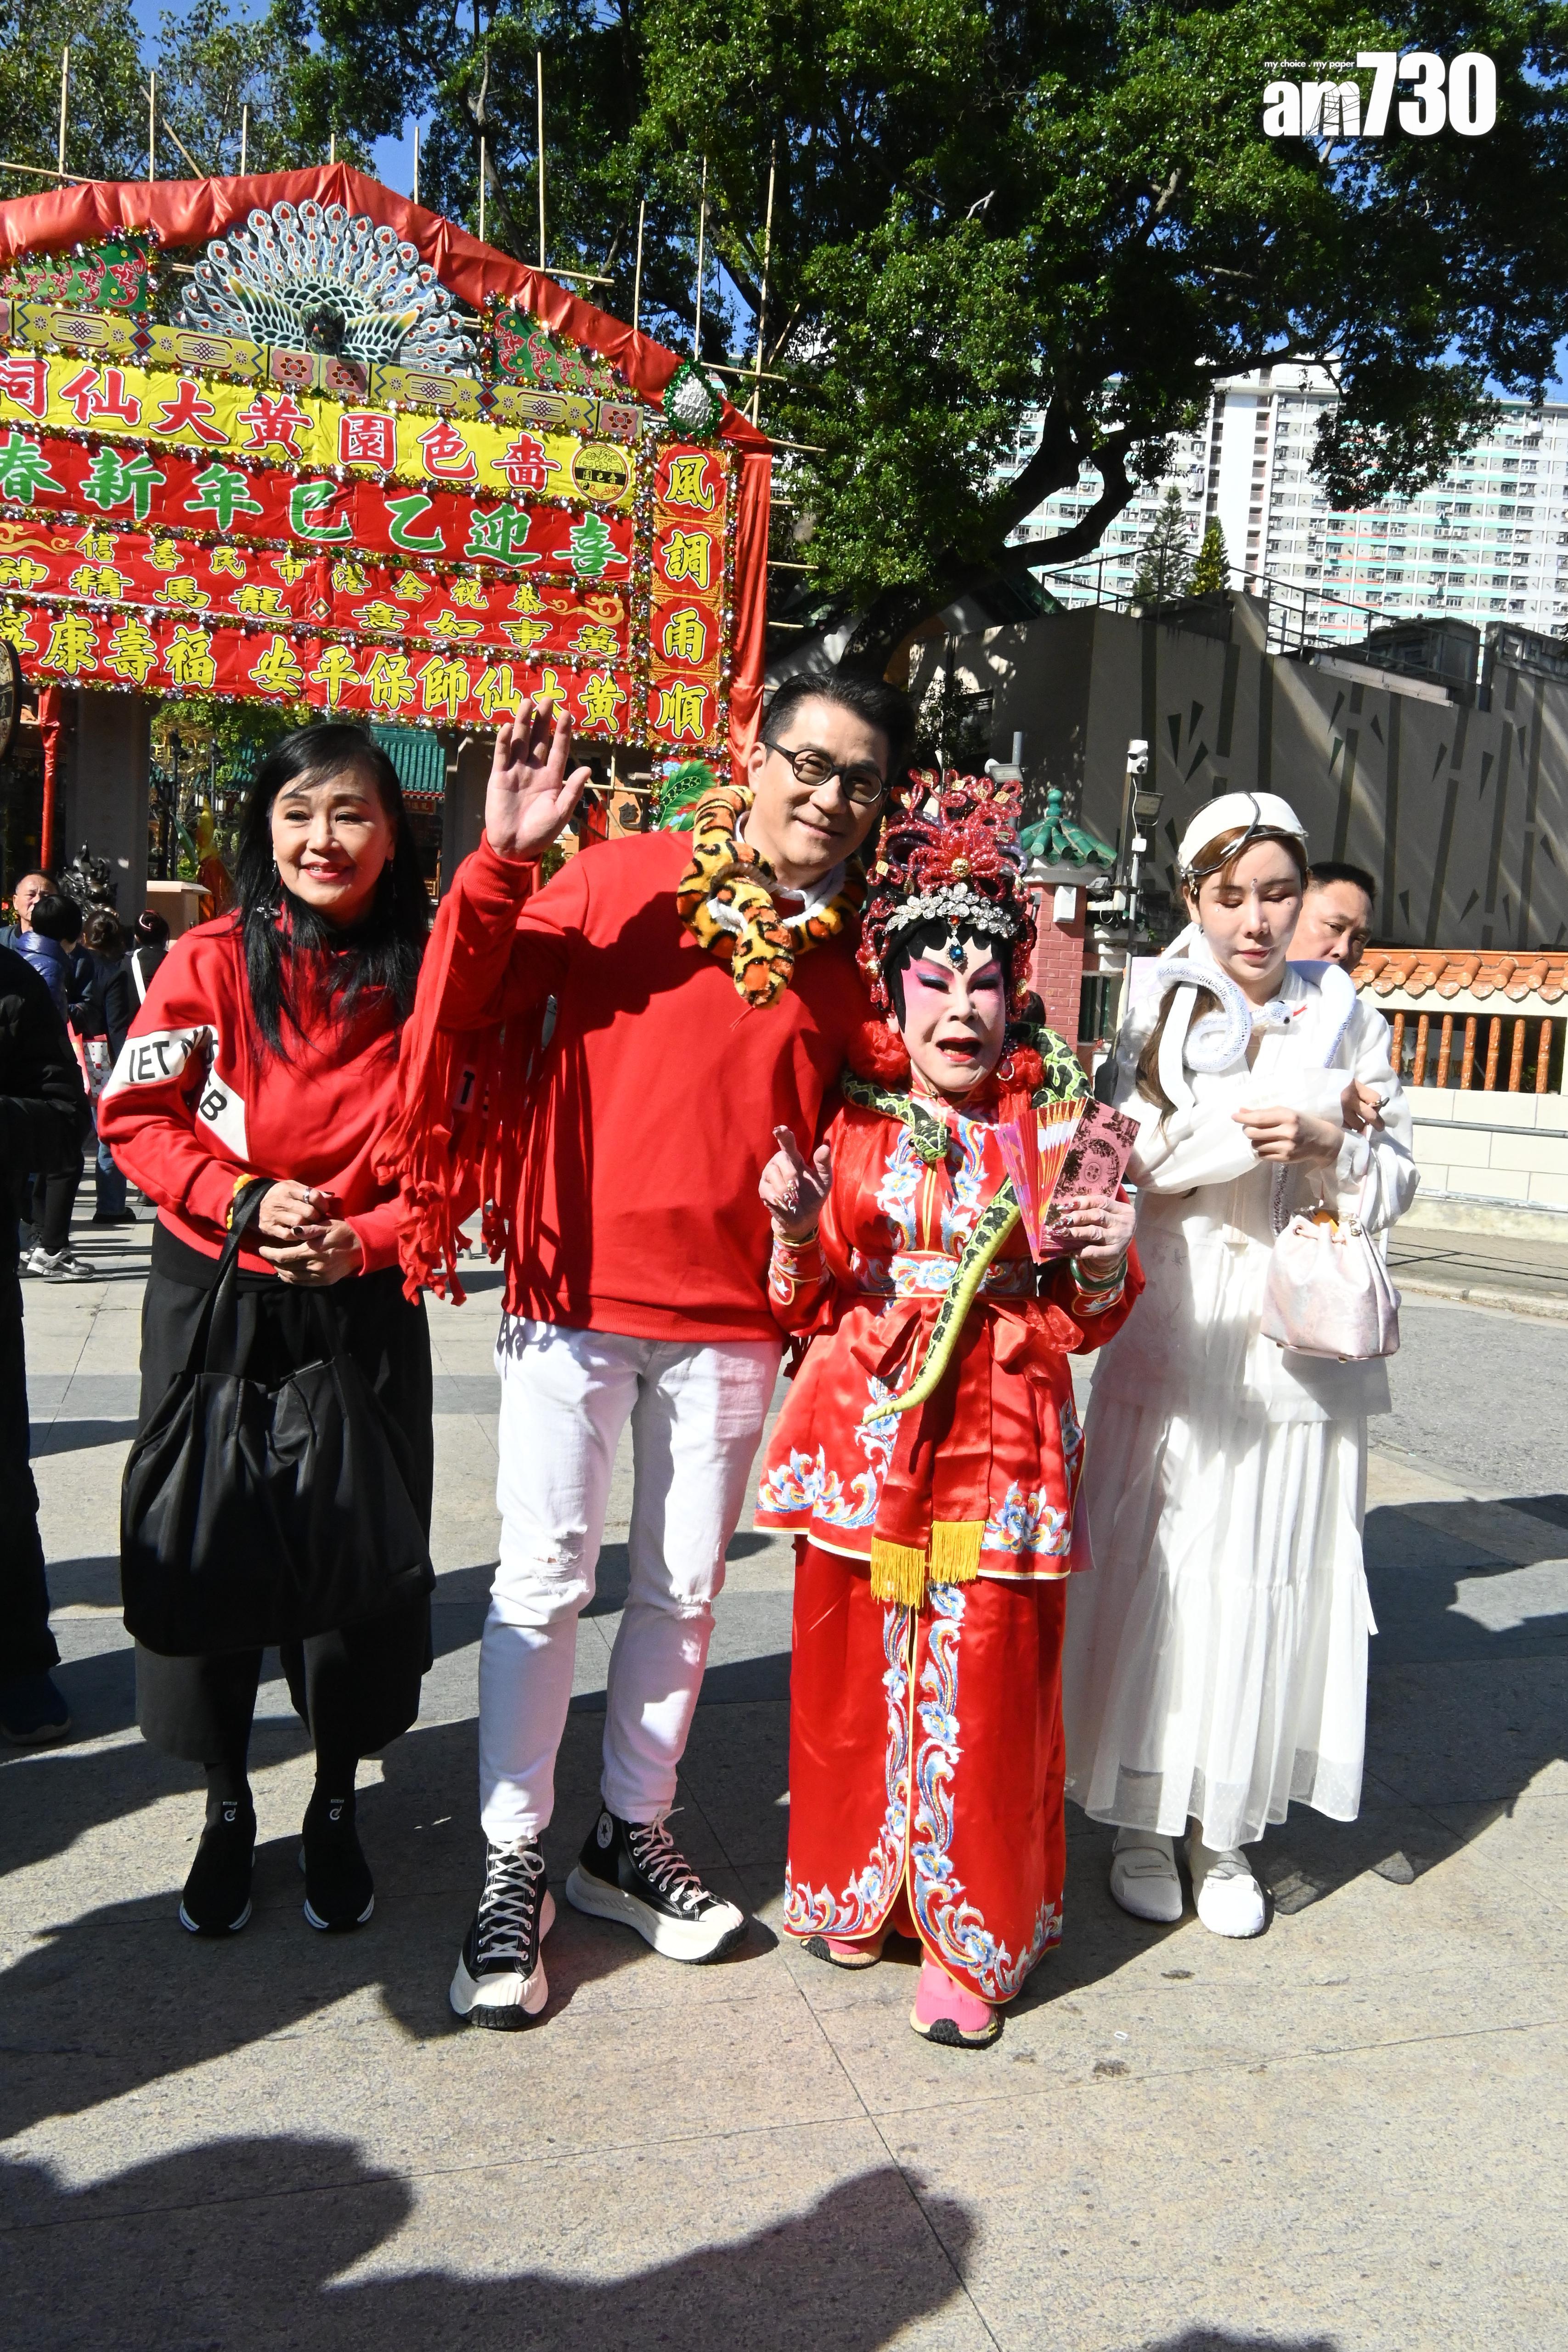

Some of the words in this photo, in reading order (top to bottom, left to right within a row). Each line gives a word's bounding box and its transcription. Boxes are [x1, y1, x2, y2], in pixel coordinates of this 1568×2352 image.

[75, 531, 547, 614] 恭祝全港市民善信
[656, 456, 715, 739] 風調雨順
